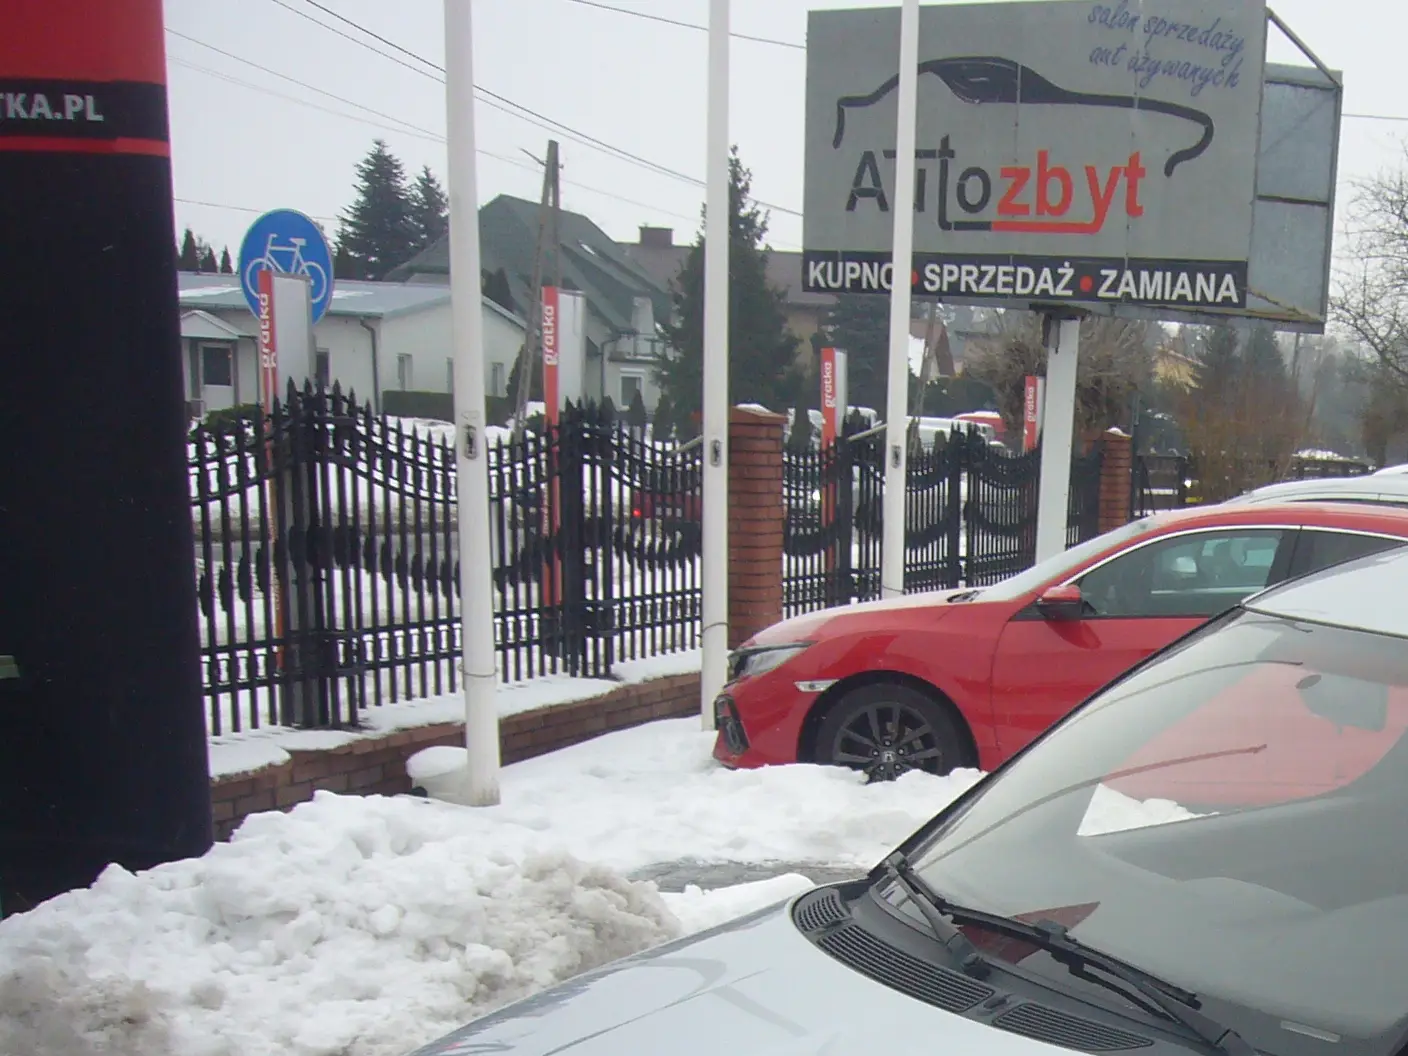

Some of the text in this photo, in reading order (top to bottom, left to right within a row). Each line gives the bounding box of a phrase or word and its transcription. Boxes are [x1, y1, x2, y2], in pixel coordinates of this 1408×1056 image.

[1087, 0, 1140, 33] salon
[1089, 42, 1127, 67] aut
[923, 261, 1075, 297] SPRZEDAŻ
[1097, 269, 1239, 303] ZAMIANA
[543, 305, 558, 366] gratka
[824, 360, 836, 409] gratka
